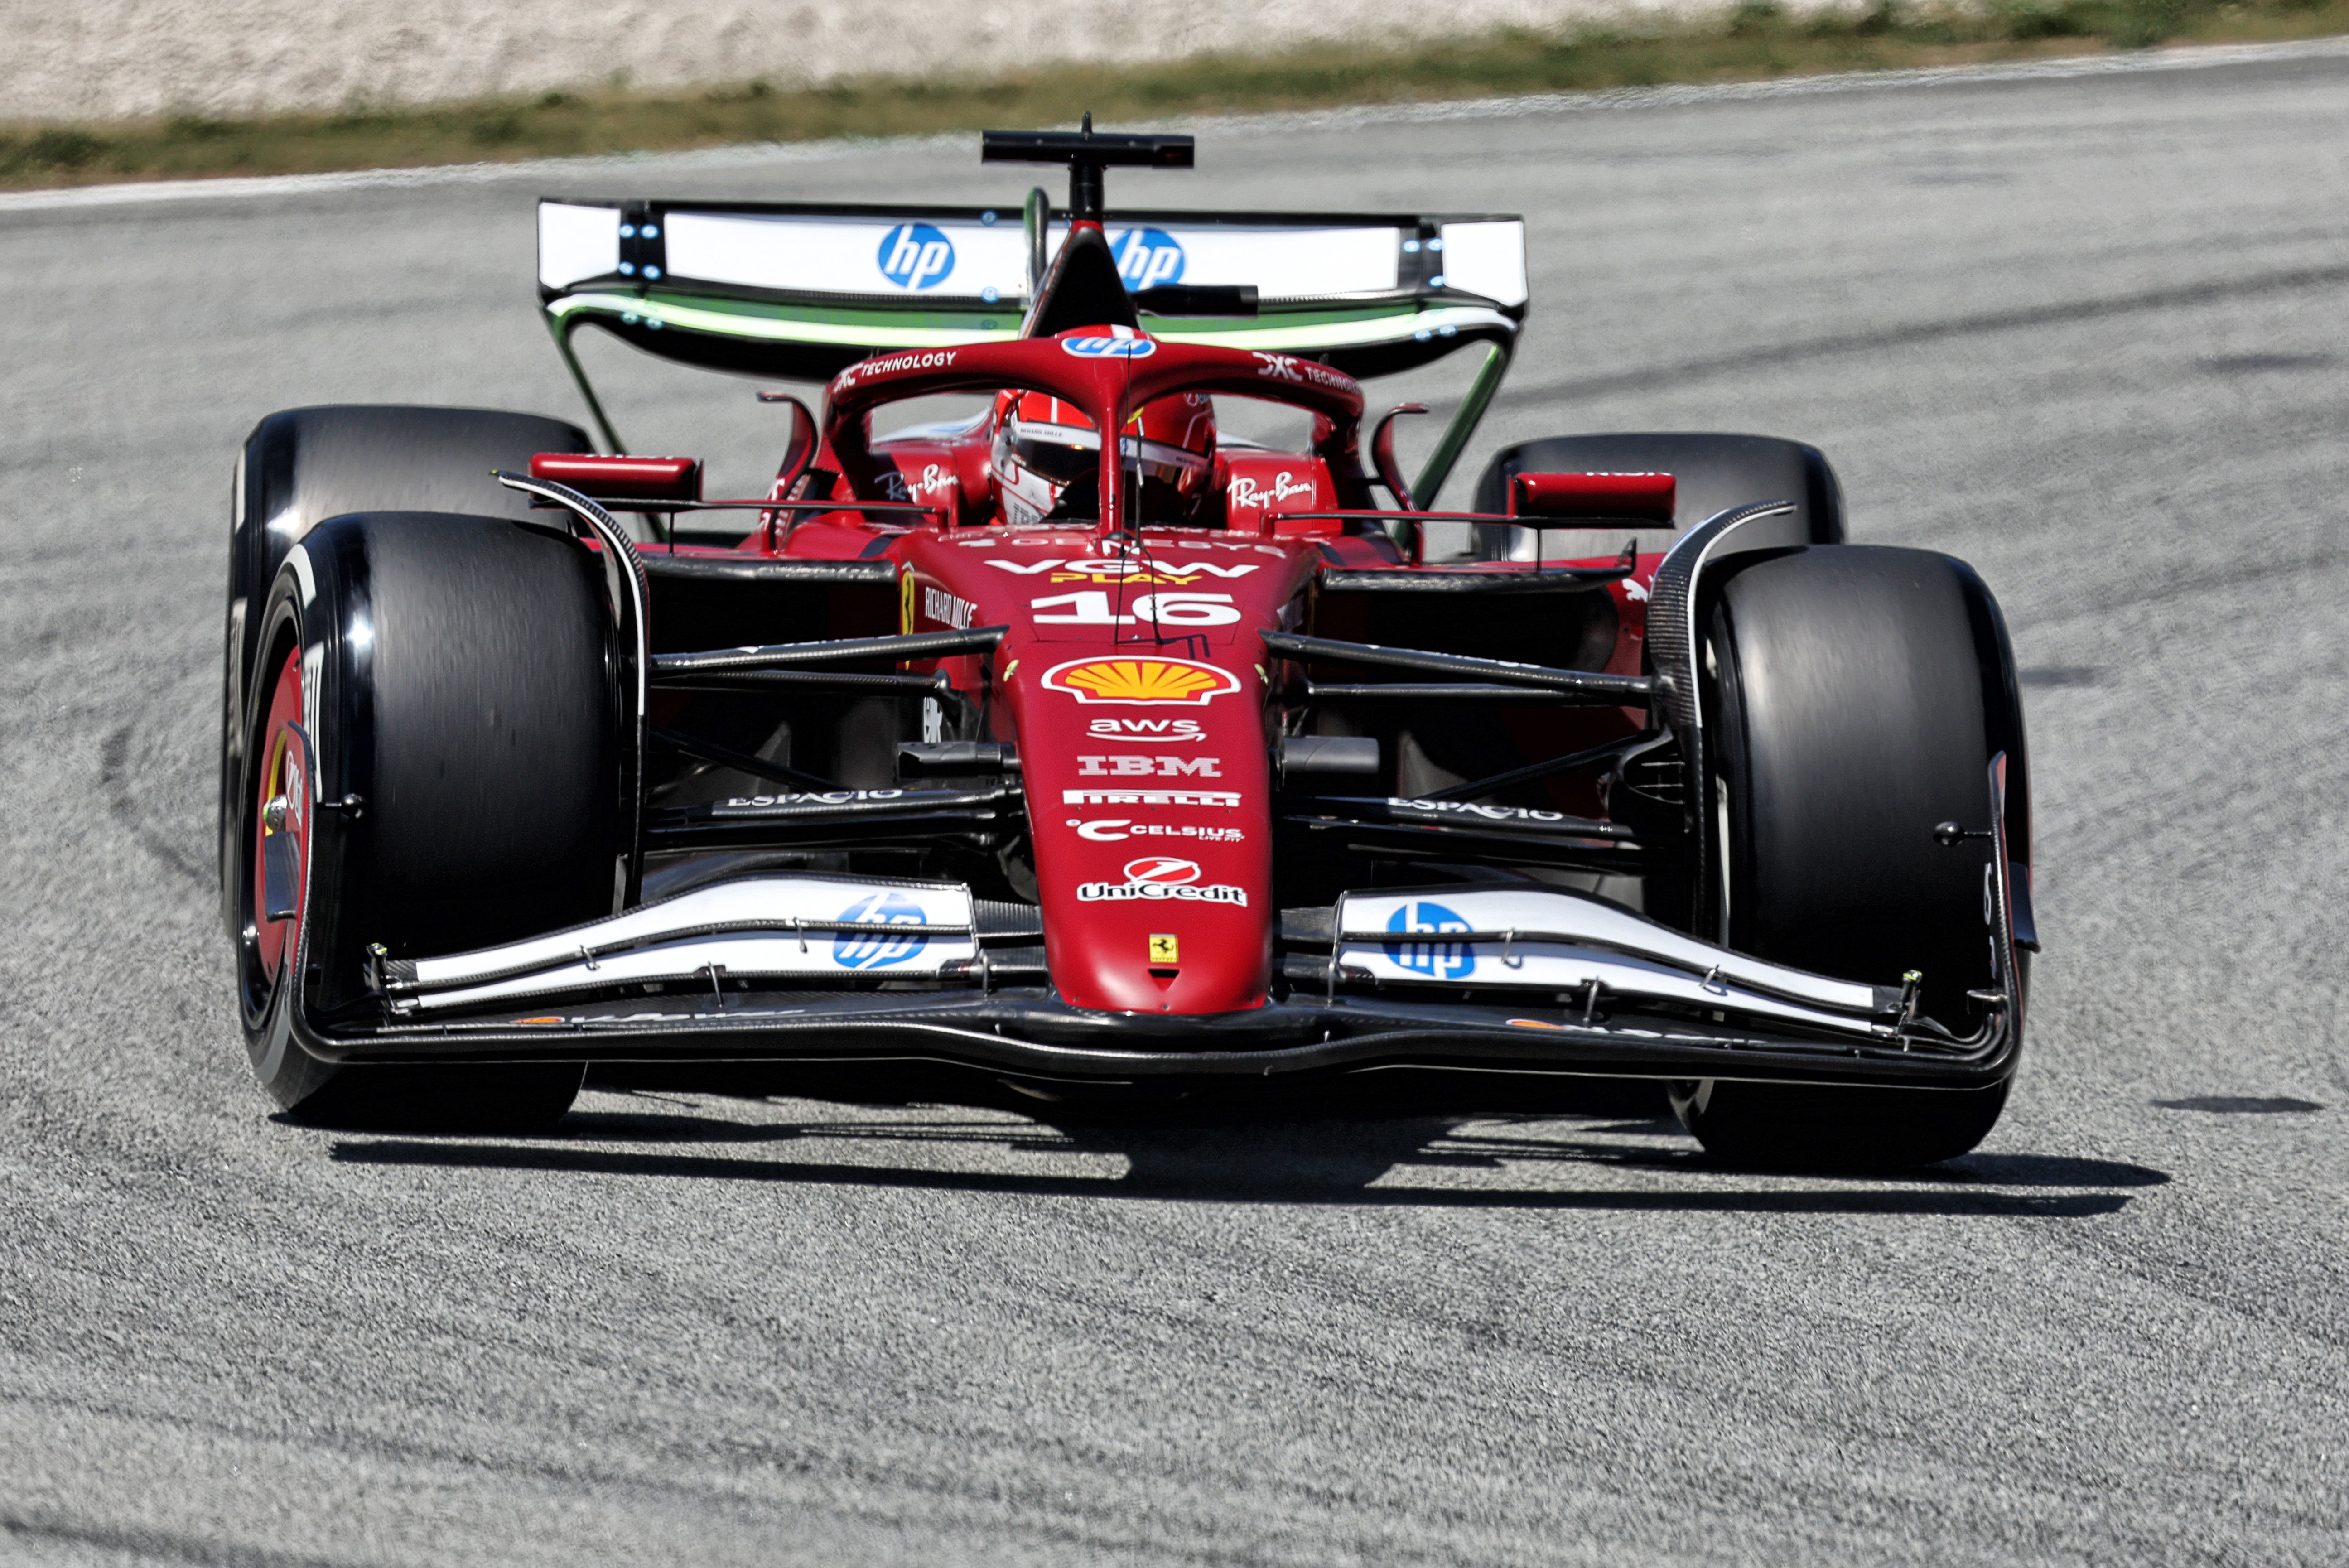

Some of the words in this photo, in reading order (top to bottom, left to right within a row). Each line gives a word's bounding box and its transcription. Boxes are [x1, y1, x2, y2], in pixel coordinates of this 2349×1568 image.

[883, 224, 952, 290] hp
[1117, 230, 1180, 291] hp
[861, 351, 957, 377] TECHNOLOGY
[874, 463, 959, 502] Ray-Ban
[1227, 471, 1312, 509] Ray-Ban
[984, 560, 1259, 578] VGW
[1051, 572, 1202, 585] PLAY
[925, 586, 952, 625] RICHARD
[950, 596, 978, 630] MILLE
[1031, 591, 1241, 626] 16
[1090, 719, 1201, 733] aws
[1077, 755, 1222, 777] IBM
[728, 789, 903, 807] ESPACIO
[1063, 789, 1242, 807] PIRELLI
[1388, 797, 1563, 821] ESPACIO
[1130, 825, 1243, 838] CELSIUS
[1080, 883, 1245, 904] UniCredit
[838, 893, 922, 970] hp
[1399, 902, 1468, 979] hp
